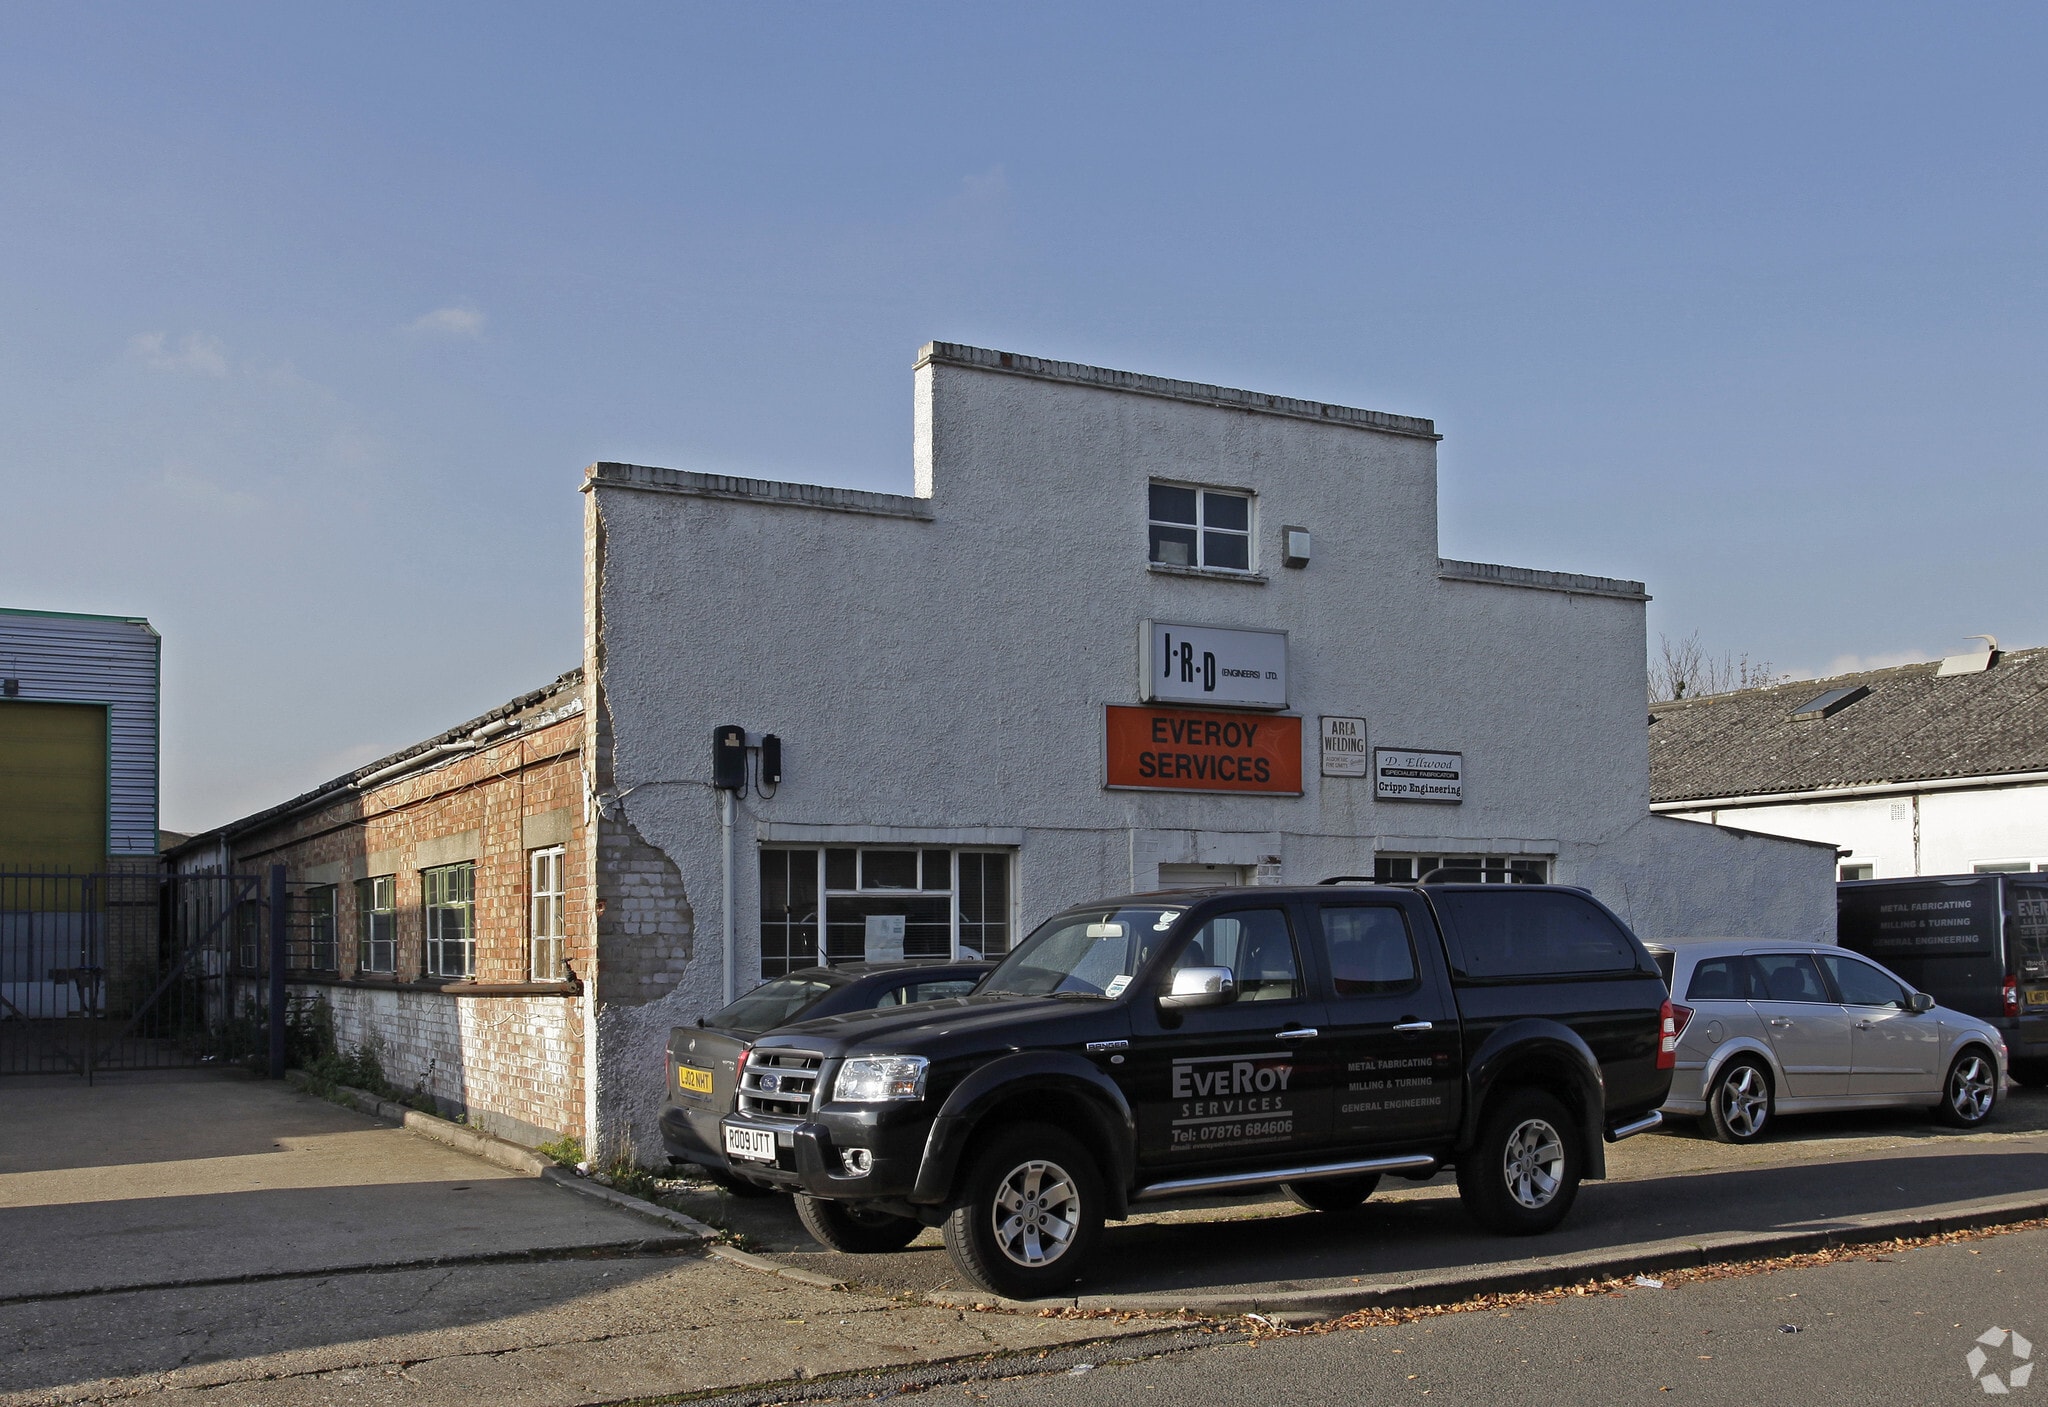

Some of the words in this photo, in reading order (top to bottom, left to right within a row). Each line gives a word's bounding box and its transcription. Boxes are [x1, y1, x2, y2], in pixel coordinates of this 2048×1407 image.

[1222, 668, 1260, 679] (ENGINEERS)
[1265, 671, 1278, 680] LTD.
[1152, 718, 1258, 748] EVEROY
[1332, 721, 1356, 736] AREA
[1325, 737, 1364, 752] WELDING
[1139, 752, 1270, 783] SERVICES
[1385, 757, 1400, 767] D.
[1405, 757, 1454, 769] Ellwood
[1385, 769, 1418, 777] SPECIALIST
[1420, 770, 1455, 778] FABRICATOR
[1409, 782, 1461, 797] Engineering
[1880, 904, 1909, 912] METAL
[1911, 900, 1972, 911] FABRICATING
[1880, 920, 1917, 929] MILLING
[1919, 920, 1926, 928] &
[1928, 918, 1970, 927] TURNING
[1873, 938, 1913, 946] GENERAL
[1915, 935, 1979, 945] ENGINEERING
[1088, 1041, 1127, 1051] RANGER
[1348, 1062, 1376, 1071] METAL
[1378, 1058, 1432, 1070] FABRICATING
[696, 1072, 709, 1089] NHT
[1349, 1081, 1384, 1091] MILLING
[1395, 1077, 1432, 1087] TURNING
[1182, 1097, 1282, 1117] SERVICES
[1342, 1101, 1382, 1112] GENERAL
[1384, 1097, 1441, 1109] ENGINEERING
[1172, 1128, 1196, 1142] Tel:
[1201, 1124, 1241, 1140] 07876
[1246, 1120, 1293, 1137] 684606
[752, 1133, 770, 1153] UTT
